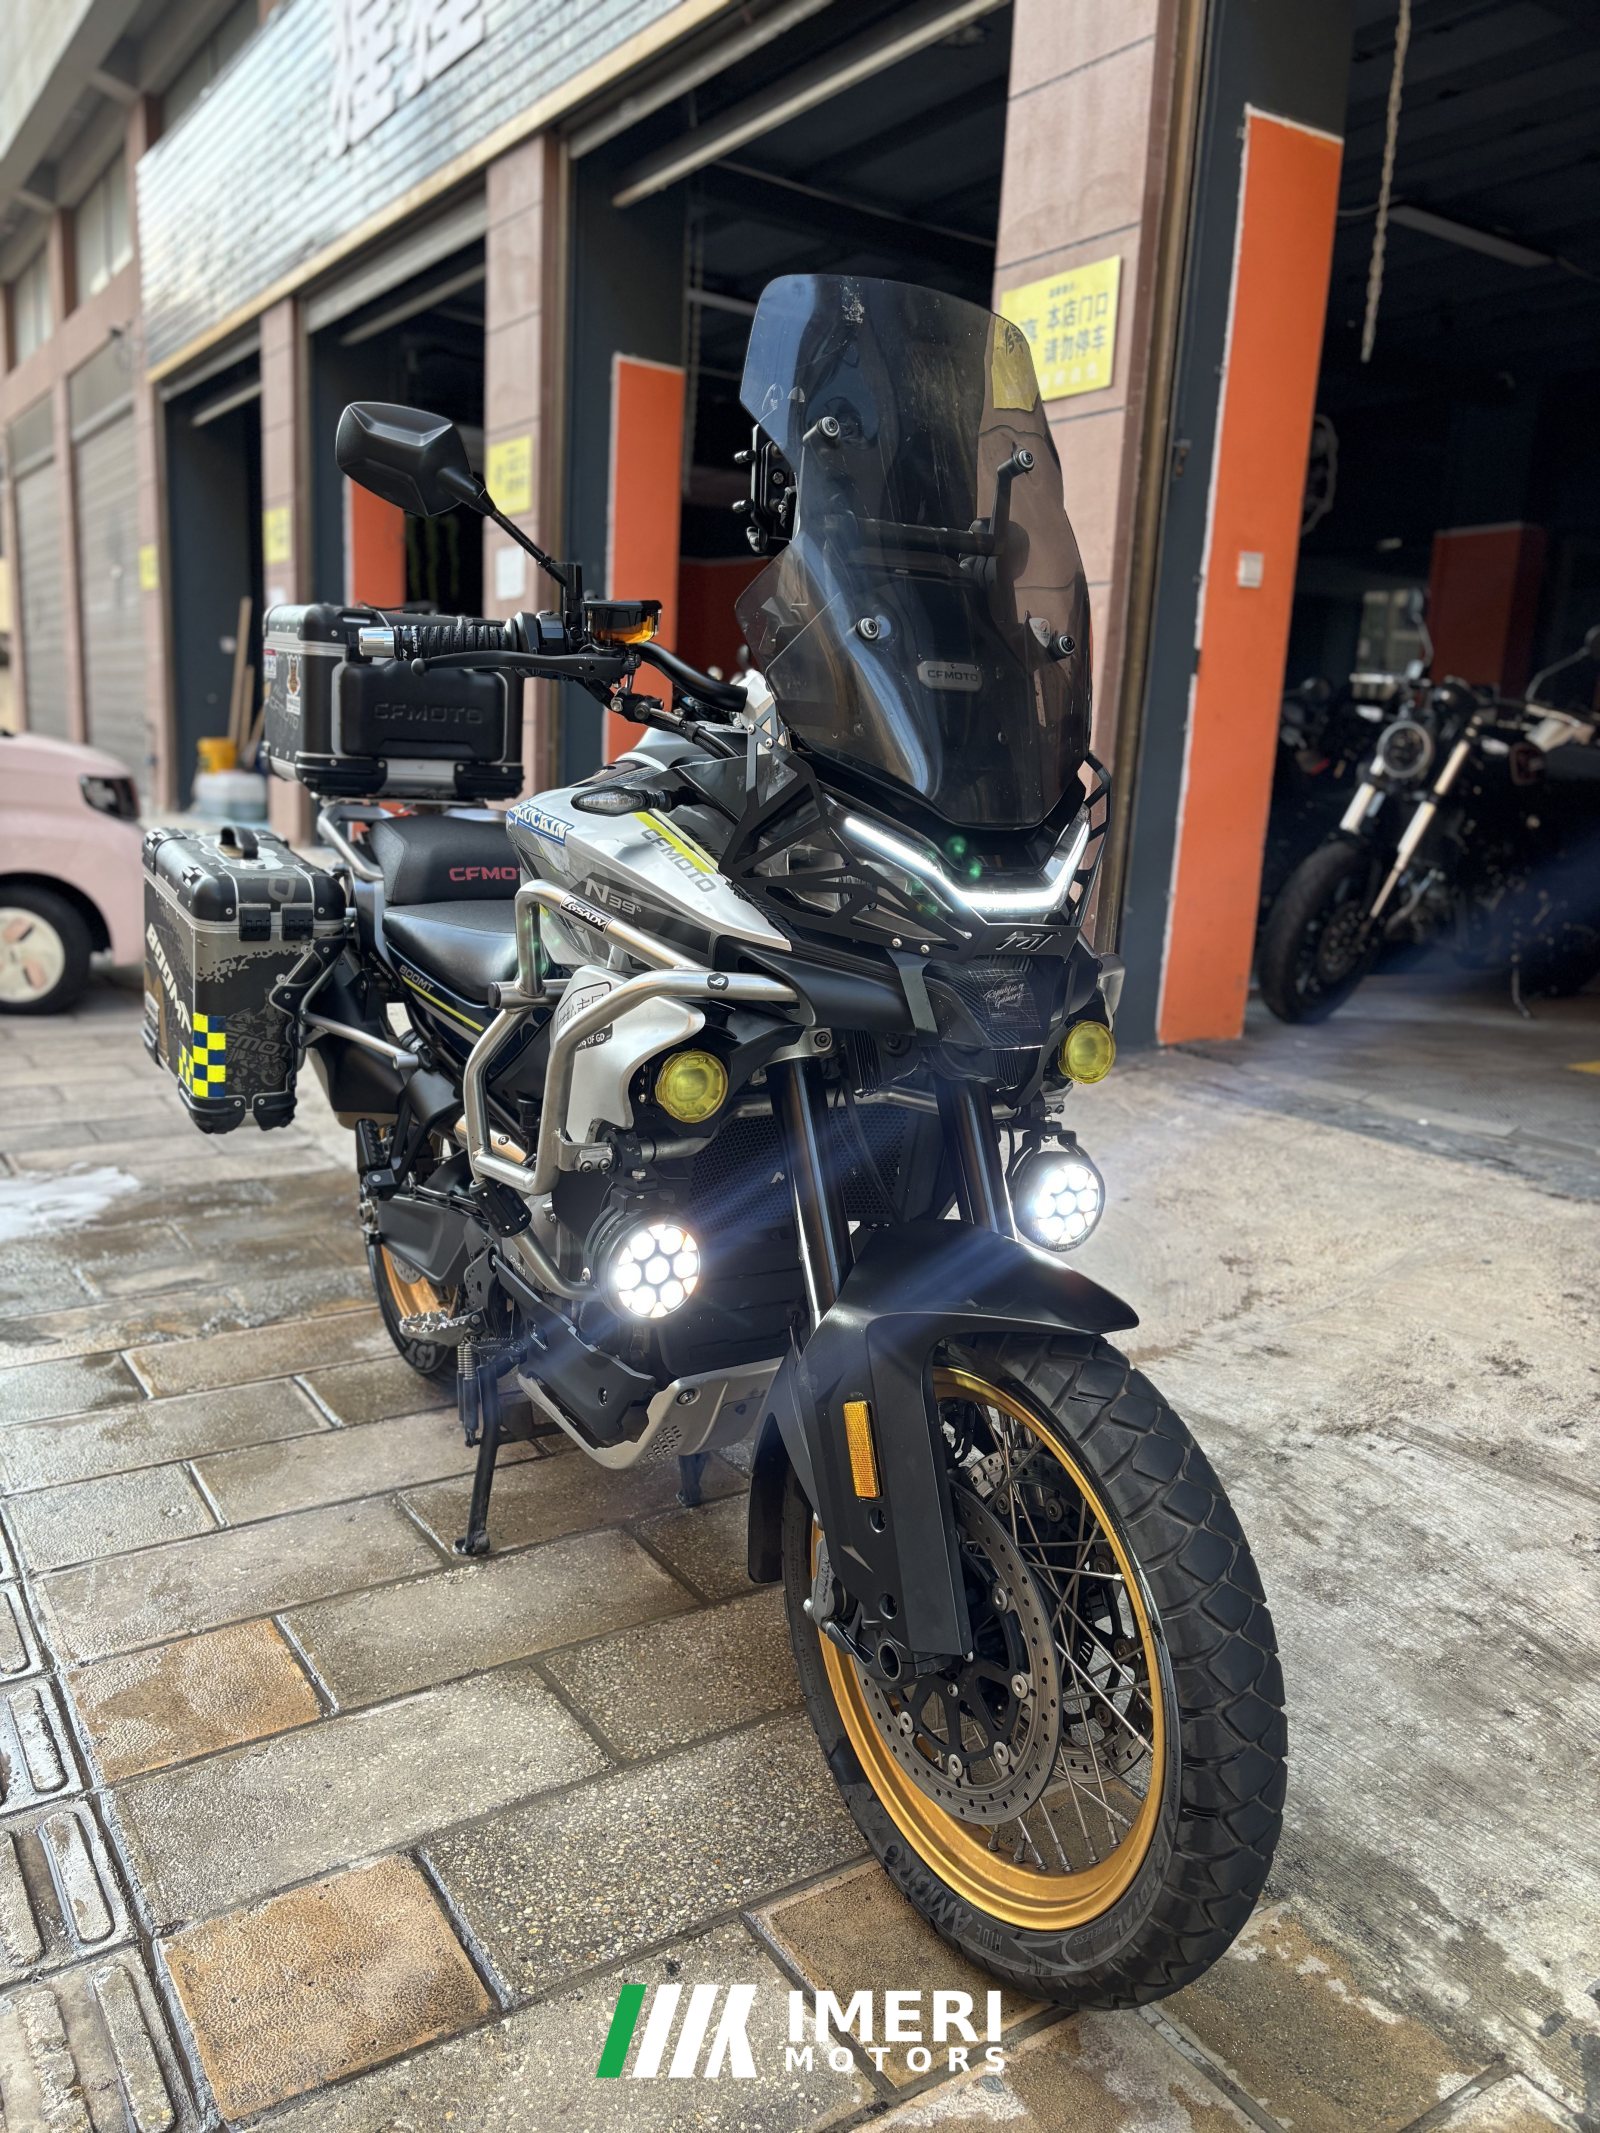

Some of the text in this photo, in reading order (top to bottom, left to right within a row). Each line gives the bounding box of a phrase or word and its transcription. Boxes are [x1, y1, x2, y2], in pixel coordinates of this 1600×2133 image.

[1047, 292, 1109, 331] 本店门口
[1043, 324, 1107, 365] 请勿停车
[927, 669, 978, 682] CFMOTO
[373, 703, 483, 724] CFMOTO
[449, 866, 521, 882] CFMO
[641, 828, 717, 892] CFMOTO
[399, 964, 435, 992] 800MT
